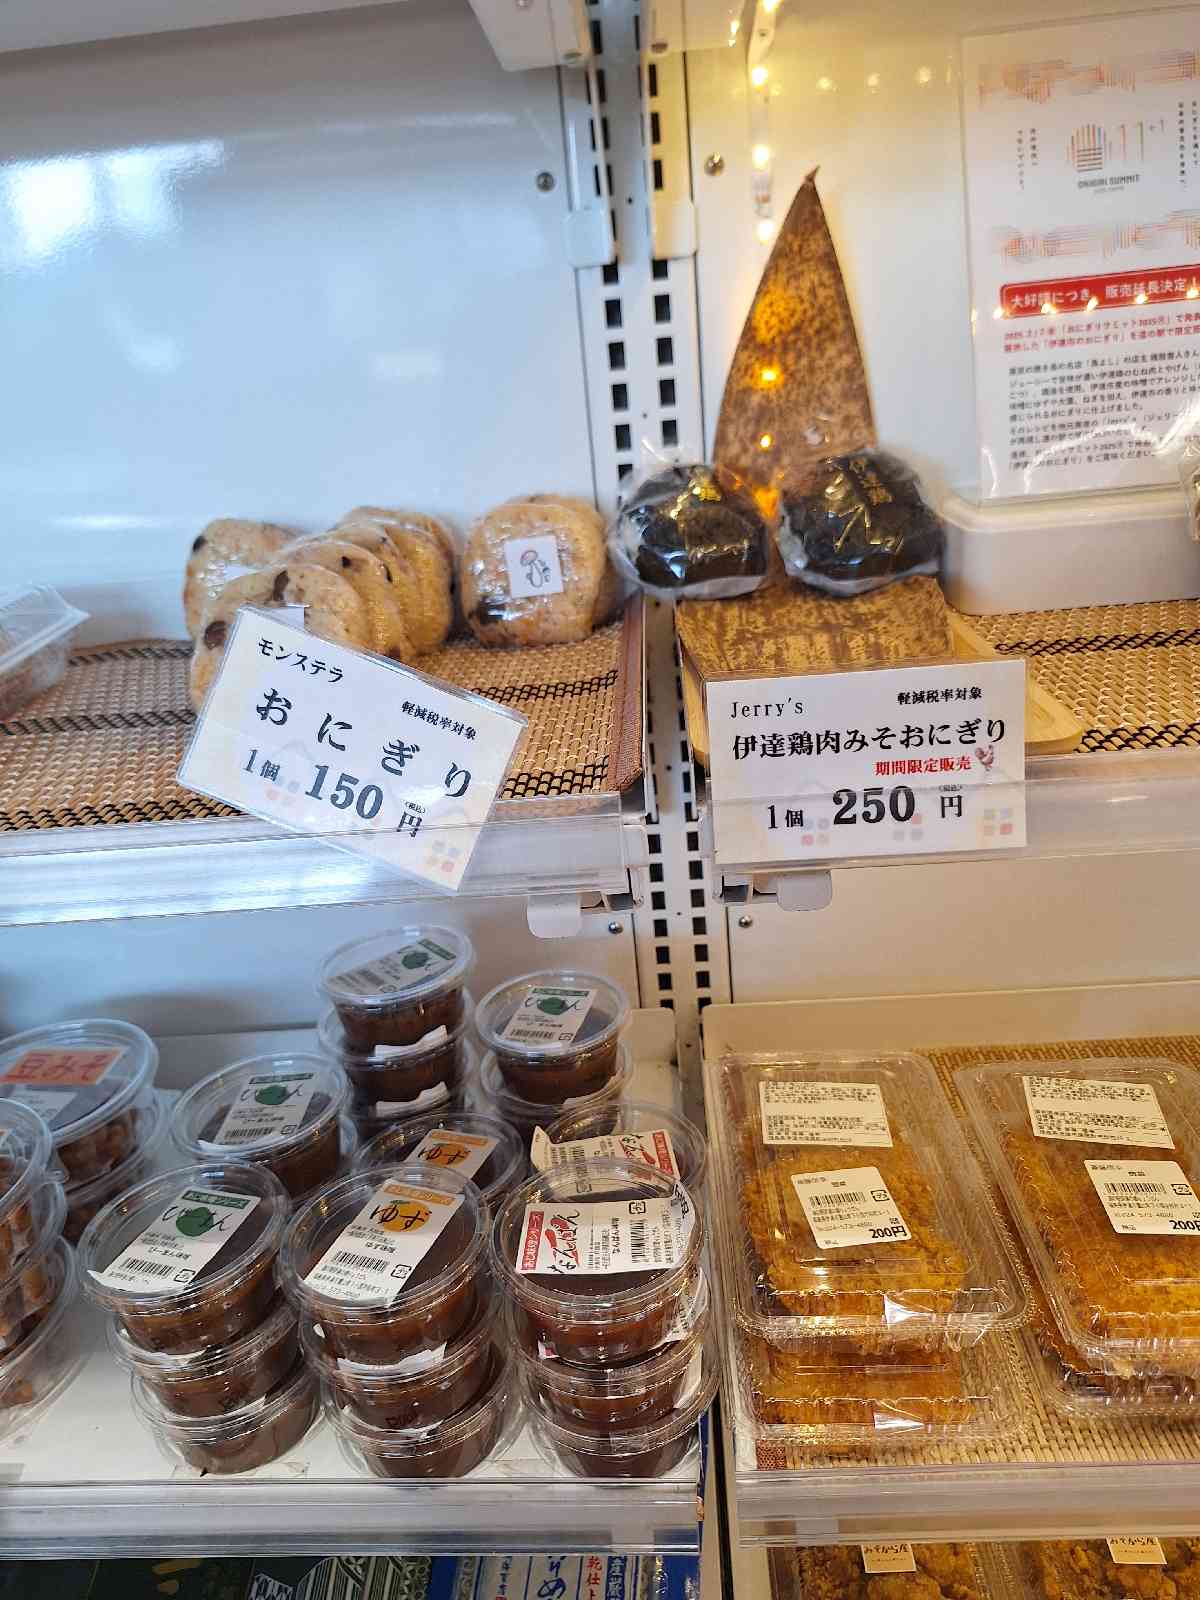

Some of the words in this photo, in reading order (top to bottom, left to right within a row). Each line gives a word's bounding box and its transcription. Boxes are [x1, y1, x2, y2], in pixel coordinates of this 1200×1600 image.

[258, 637, 345, 684] モンステラ
[401, 699, 479, 742] 軽減税率対象
[730, 697, 805, 720] Jerry's
[896, 686, 984, 706] 軽減税率対象
[732, 718, 1006, 761] 伊達鶏肉みそおにぎり
[872, 755, 973, 777] 期間限定販売
[304, 763, 384, 821] 150
[397, 811, 424, 838] 円
[832, 785, 916, 826] 250
[939, 794, 964, 819] 円
[369, 1203, 433, 1231] ゆず
[871, 1225, 908, 1240] 200円
